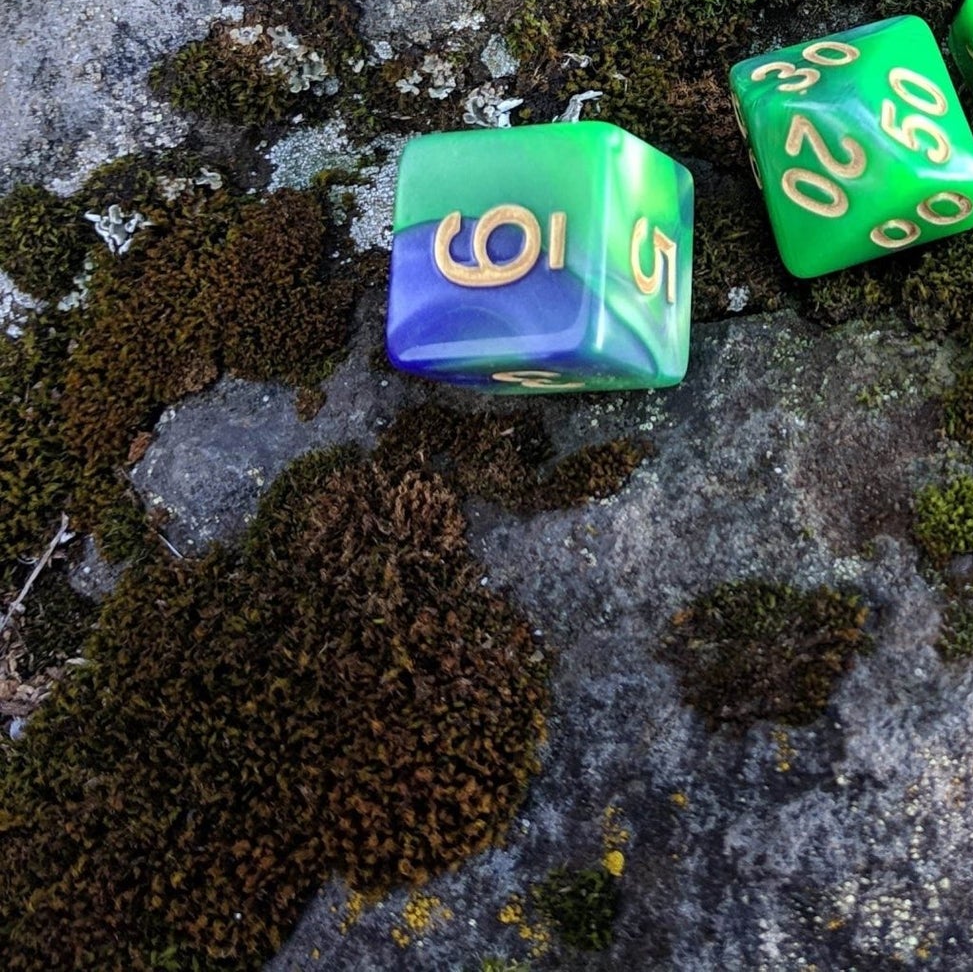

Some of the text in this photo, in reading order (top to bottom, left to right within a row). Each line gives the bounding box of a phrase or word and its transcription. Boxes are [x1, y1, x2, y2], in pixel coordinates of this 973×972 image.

[751, 41, 860, 95] 30
[880, 67, 951, 165] 50
[780, 114, 868, 219] 20
[630, 216, 678, 305] 5
